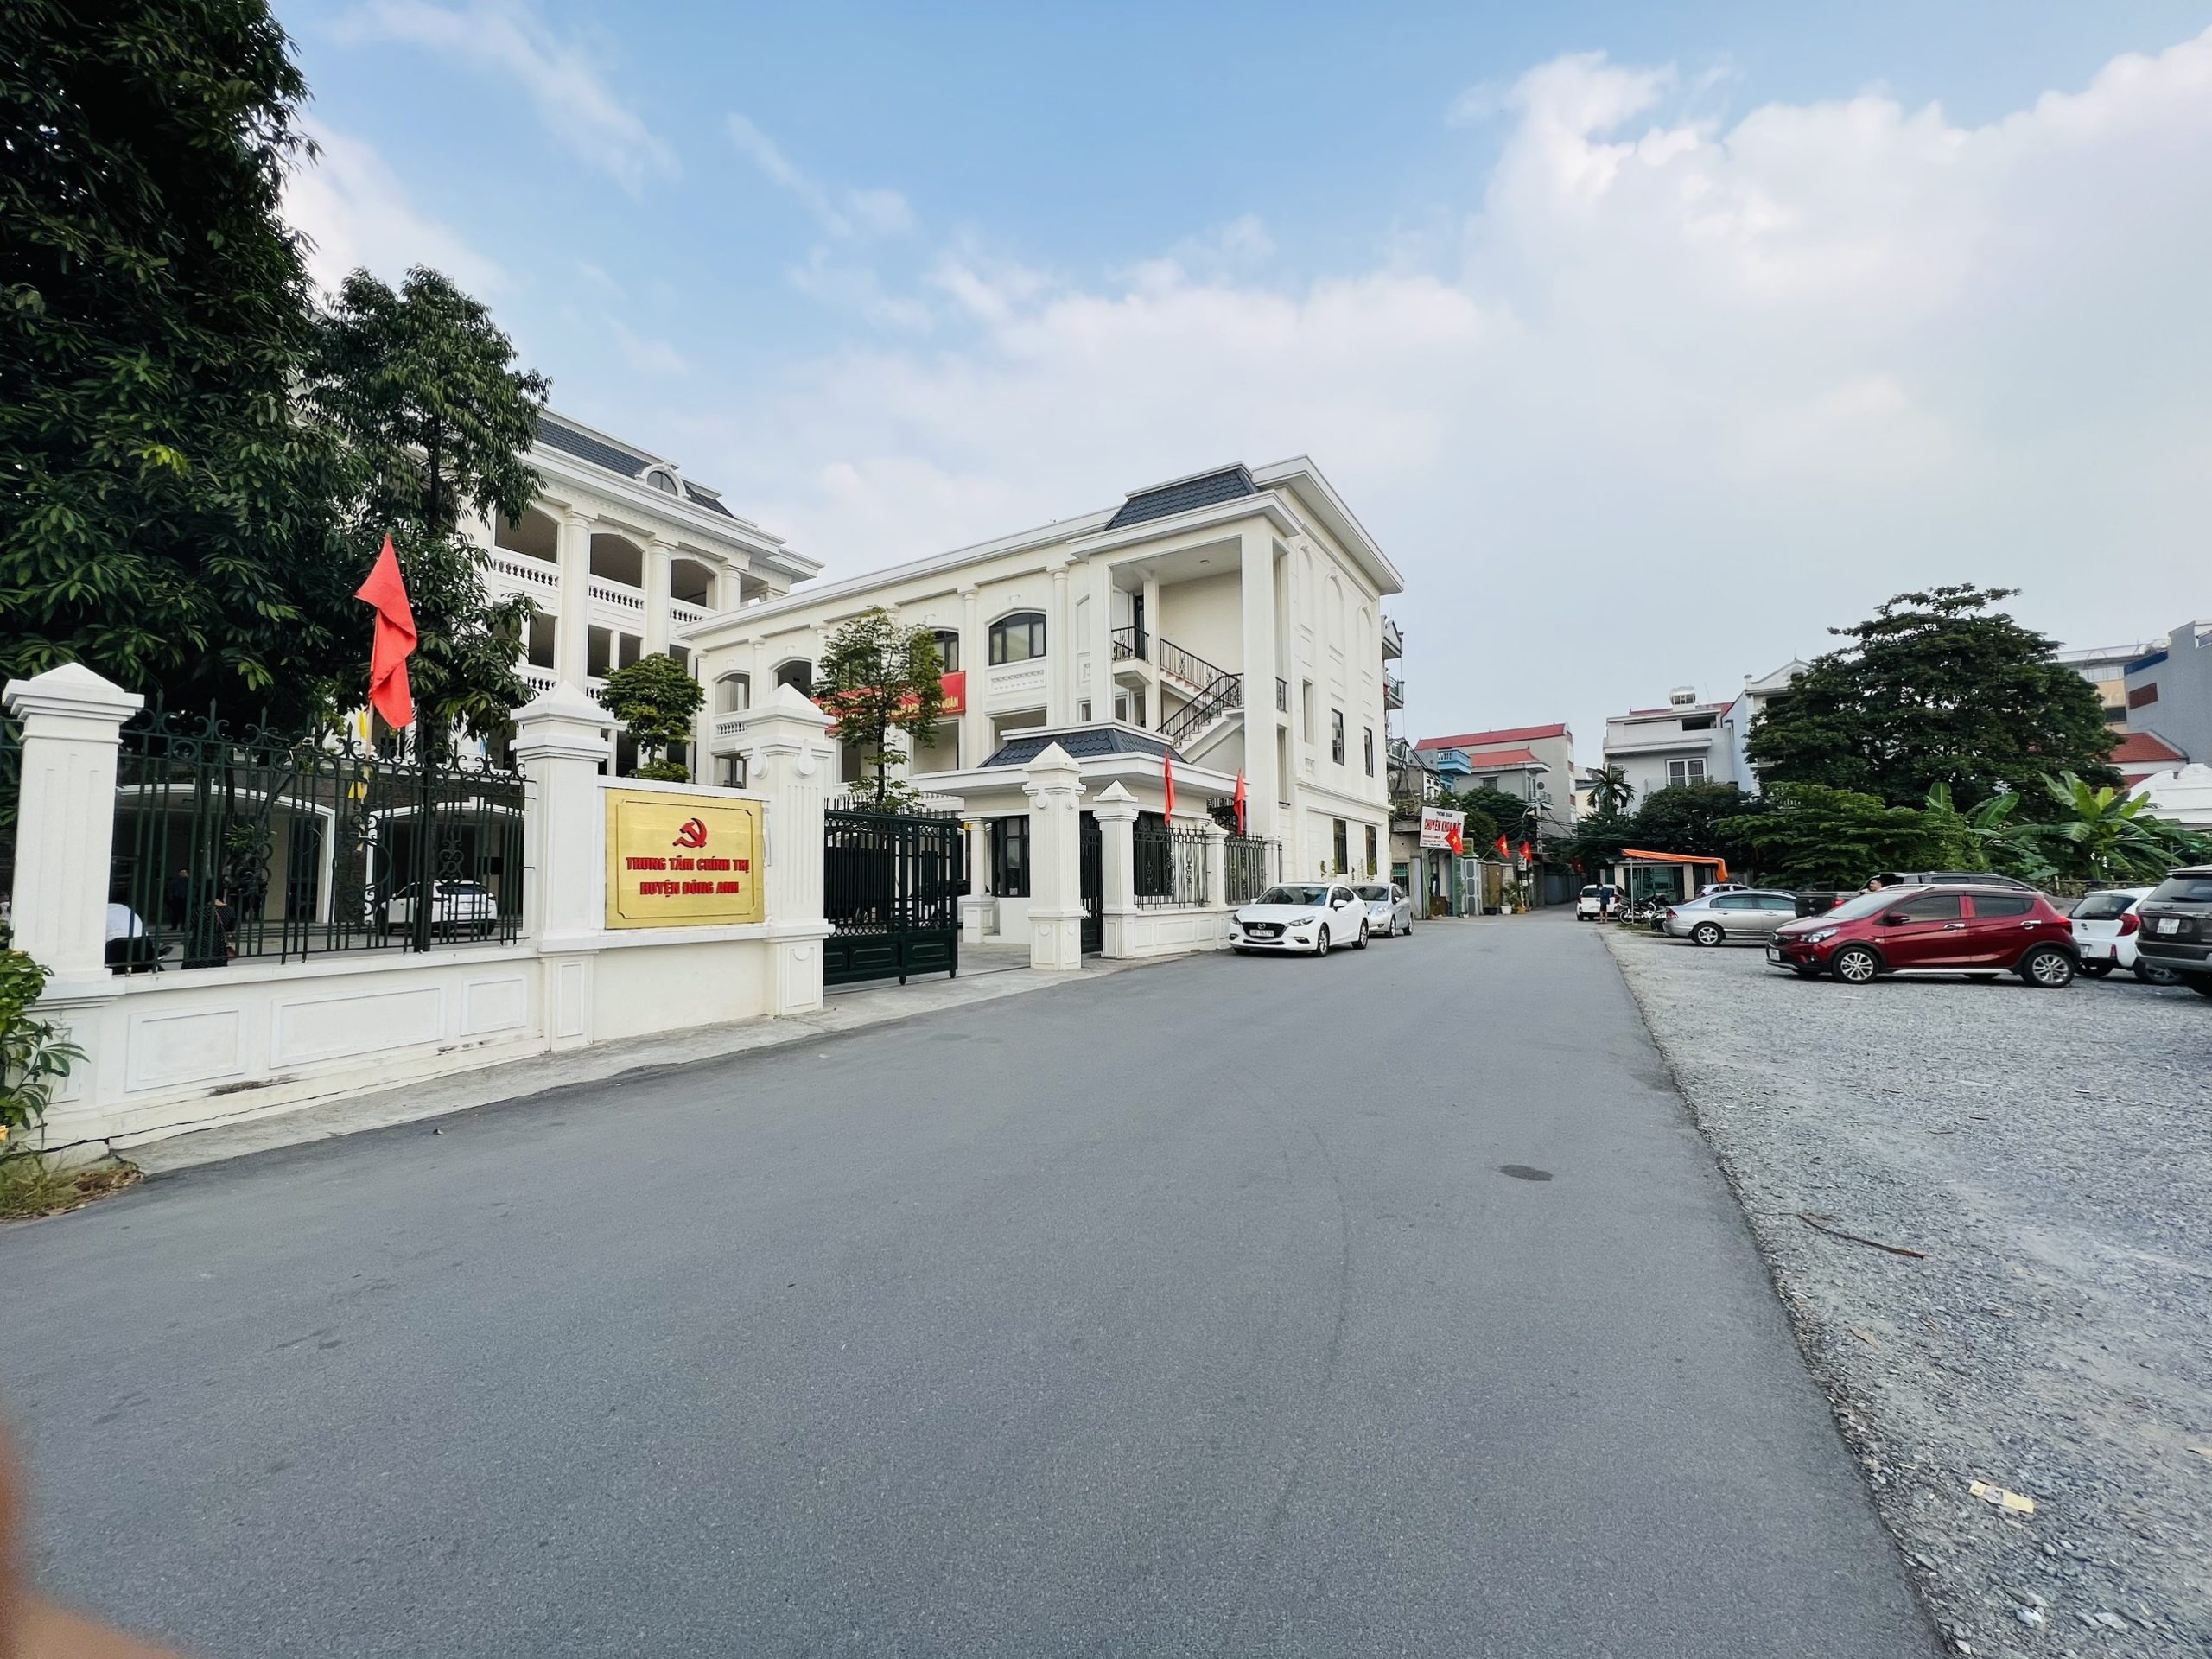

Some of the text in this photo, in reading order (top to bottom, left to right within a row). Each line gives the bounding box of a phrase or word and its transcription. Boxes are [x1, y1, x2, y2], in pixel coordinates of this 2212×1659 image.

[626, 855, 749, 874] TRUNG TÂM CHÍNH TRỊ
[639, 879, 739, 898] HUYỆN ĐÔNG ANH
